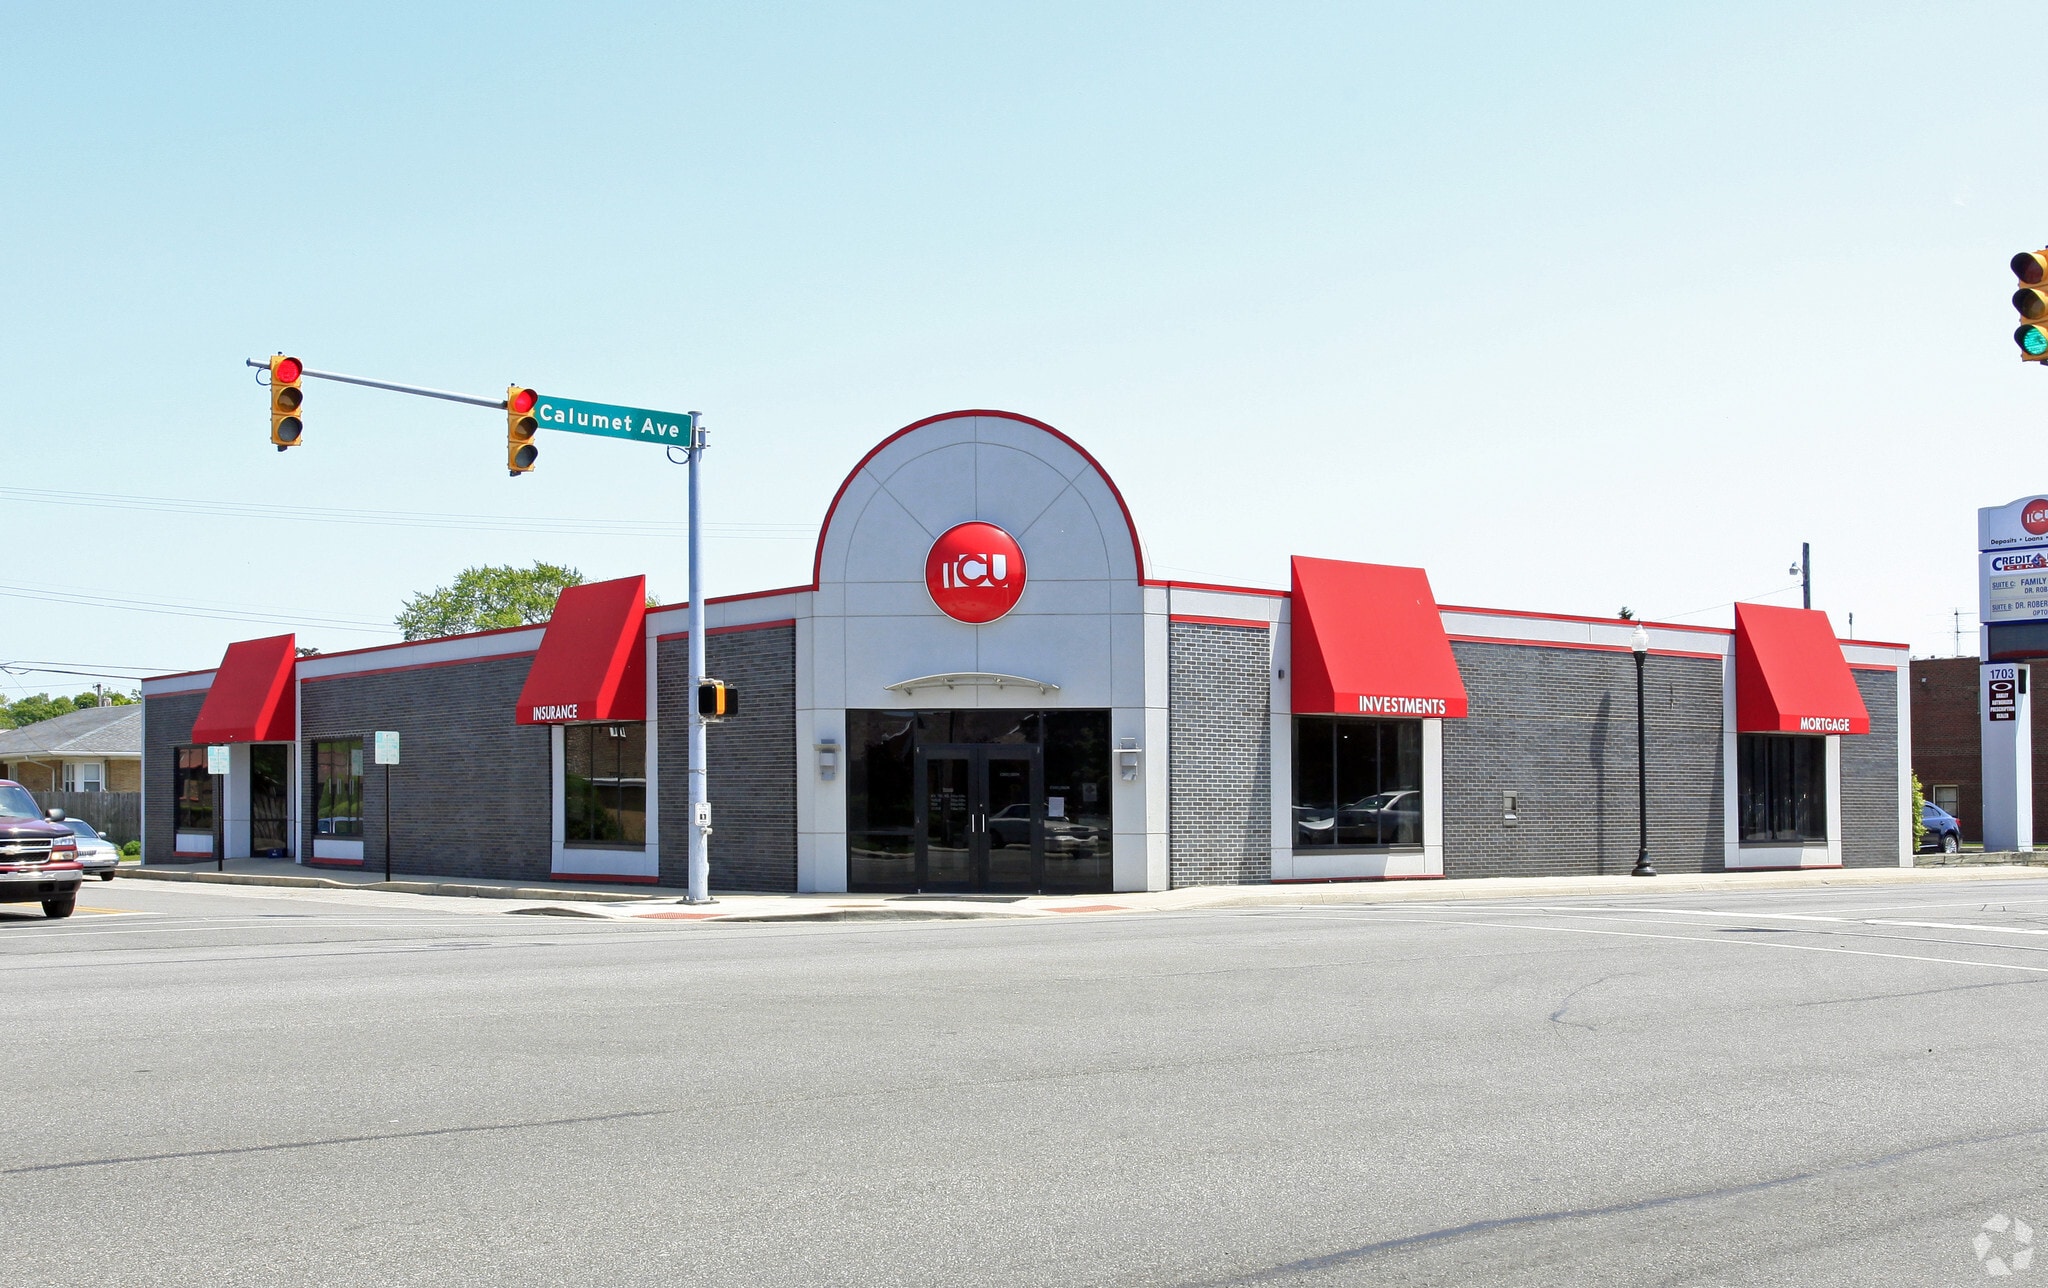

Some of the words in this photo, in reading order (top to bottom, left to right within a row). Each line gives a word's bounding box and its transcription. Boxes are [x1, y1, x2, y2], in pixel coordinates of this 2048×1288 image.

[540, 404, 632, 431] Calumet
[641, 418, 679, 438] Ave
[1992, 555, 2031, 571] CREDIT
[2021, 577, 2047, 586] FAMILY
[1990, 668, 2014, 679] 1703
[533, 704, 578, 721] INSURANCE
[1359, 695, 1446, 714] INVESTMENTS
[1800, 717, 1850, 732] MORTGAGE
